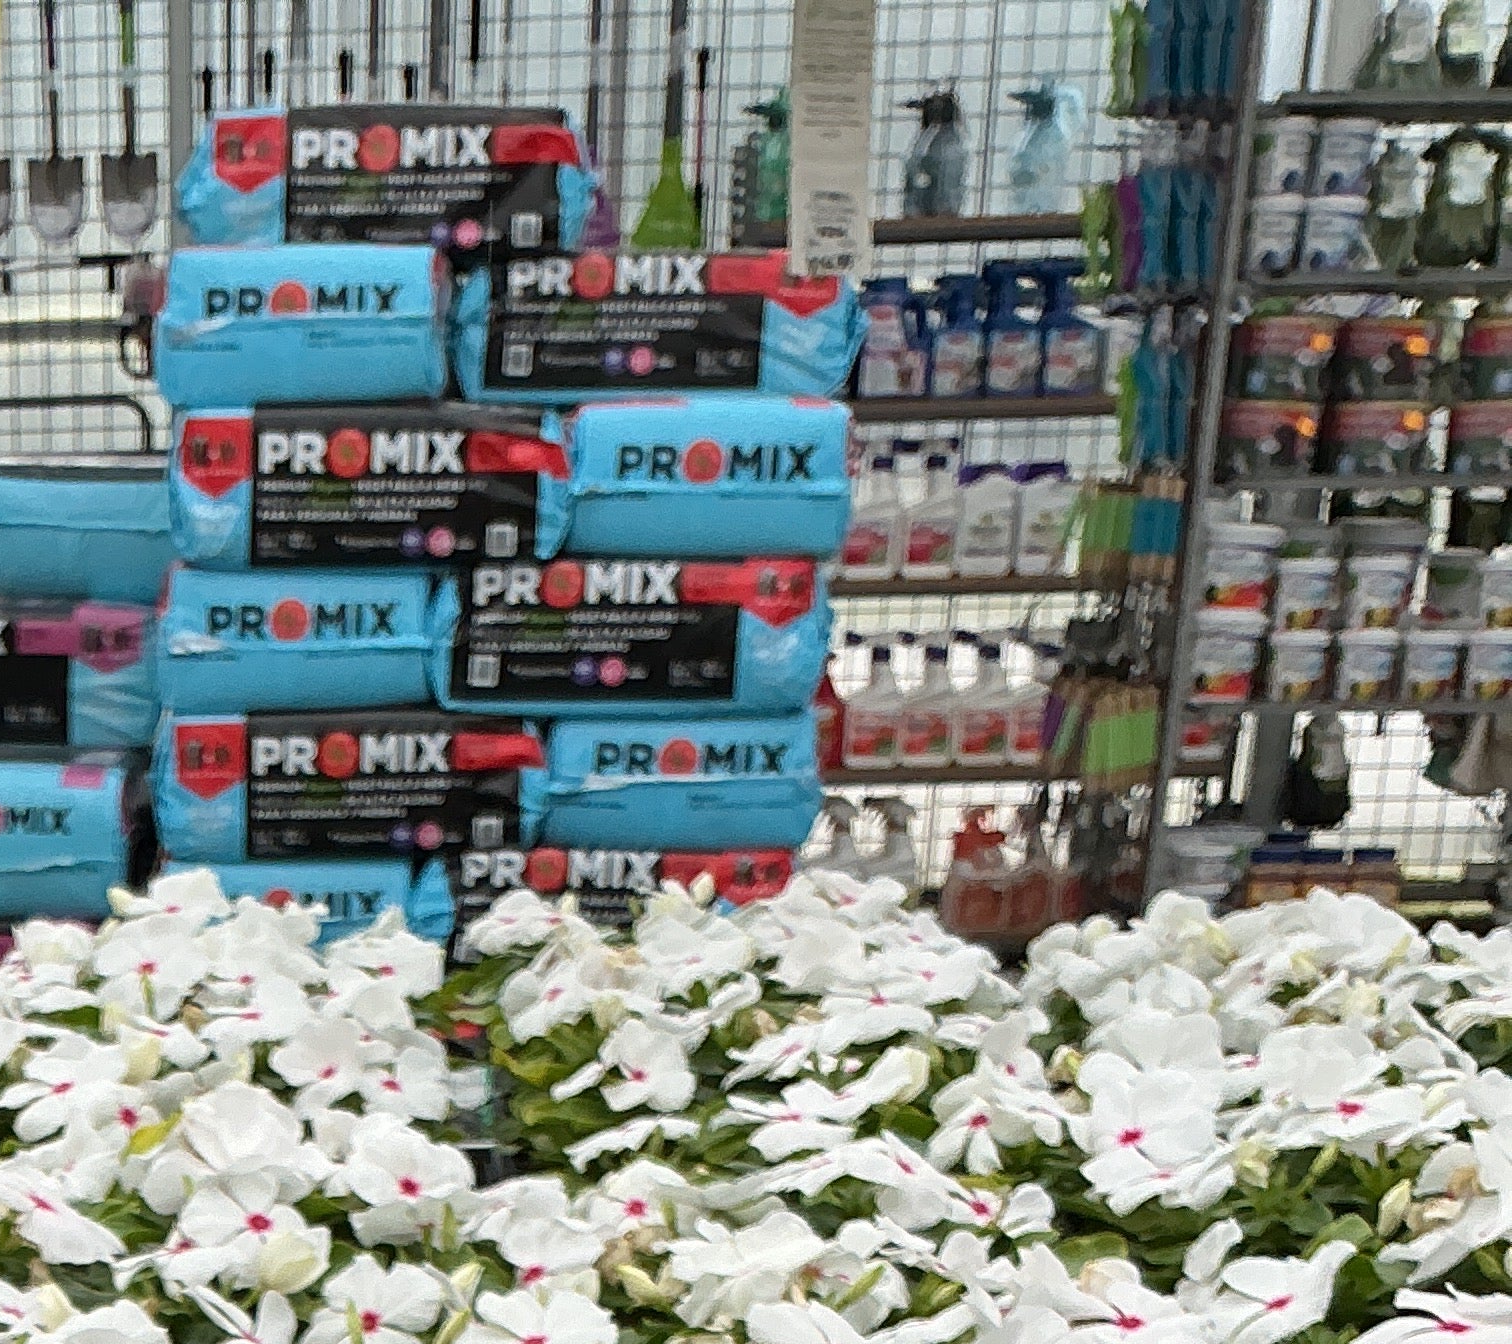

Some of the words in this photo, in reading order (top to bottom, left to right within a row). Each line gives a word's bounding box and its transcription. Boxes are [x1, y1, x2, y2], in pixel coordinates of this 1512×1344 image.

[291, 124, 492, 172] PROMIX
[506, 251, 708, 299] PROMIX
[202, 280, 404, 319] PROMIX
[257, 428, 466, 479] PROMIX
[618, 439, 819, 484] PROMIX
[472, 560, 681, 608] PROMIX
[207, 598, 397, 641] PROMIX
[250, 731, 452, 779] PROMIX
[593, 737, 787, 777] PROMIX
[461, 847, 661, 896] PROMIX
